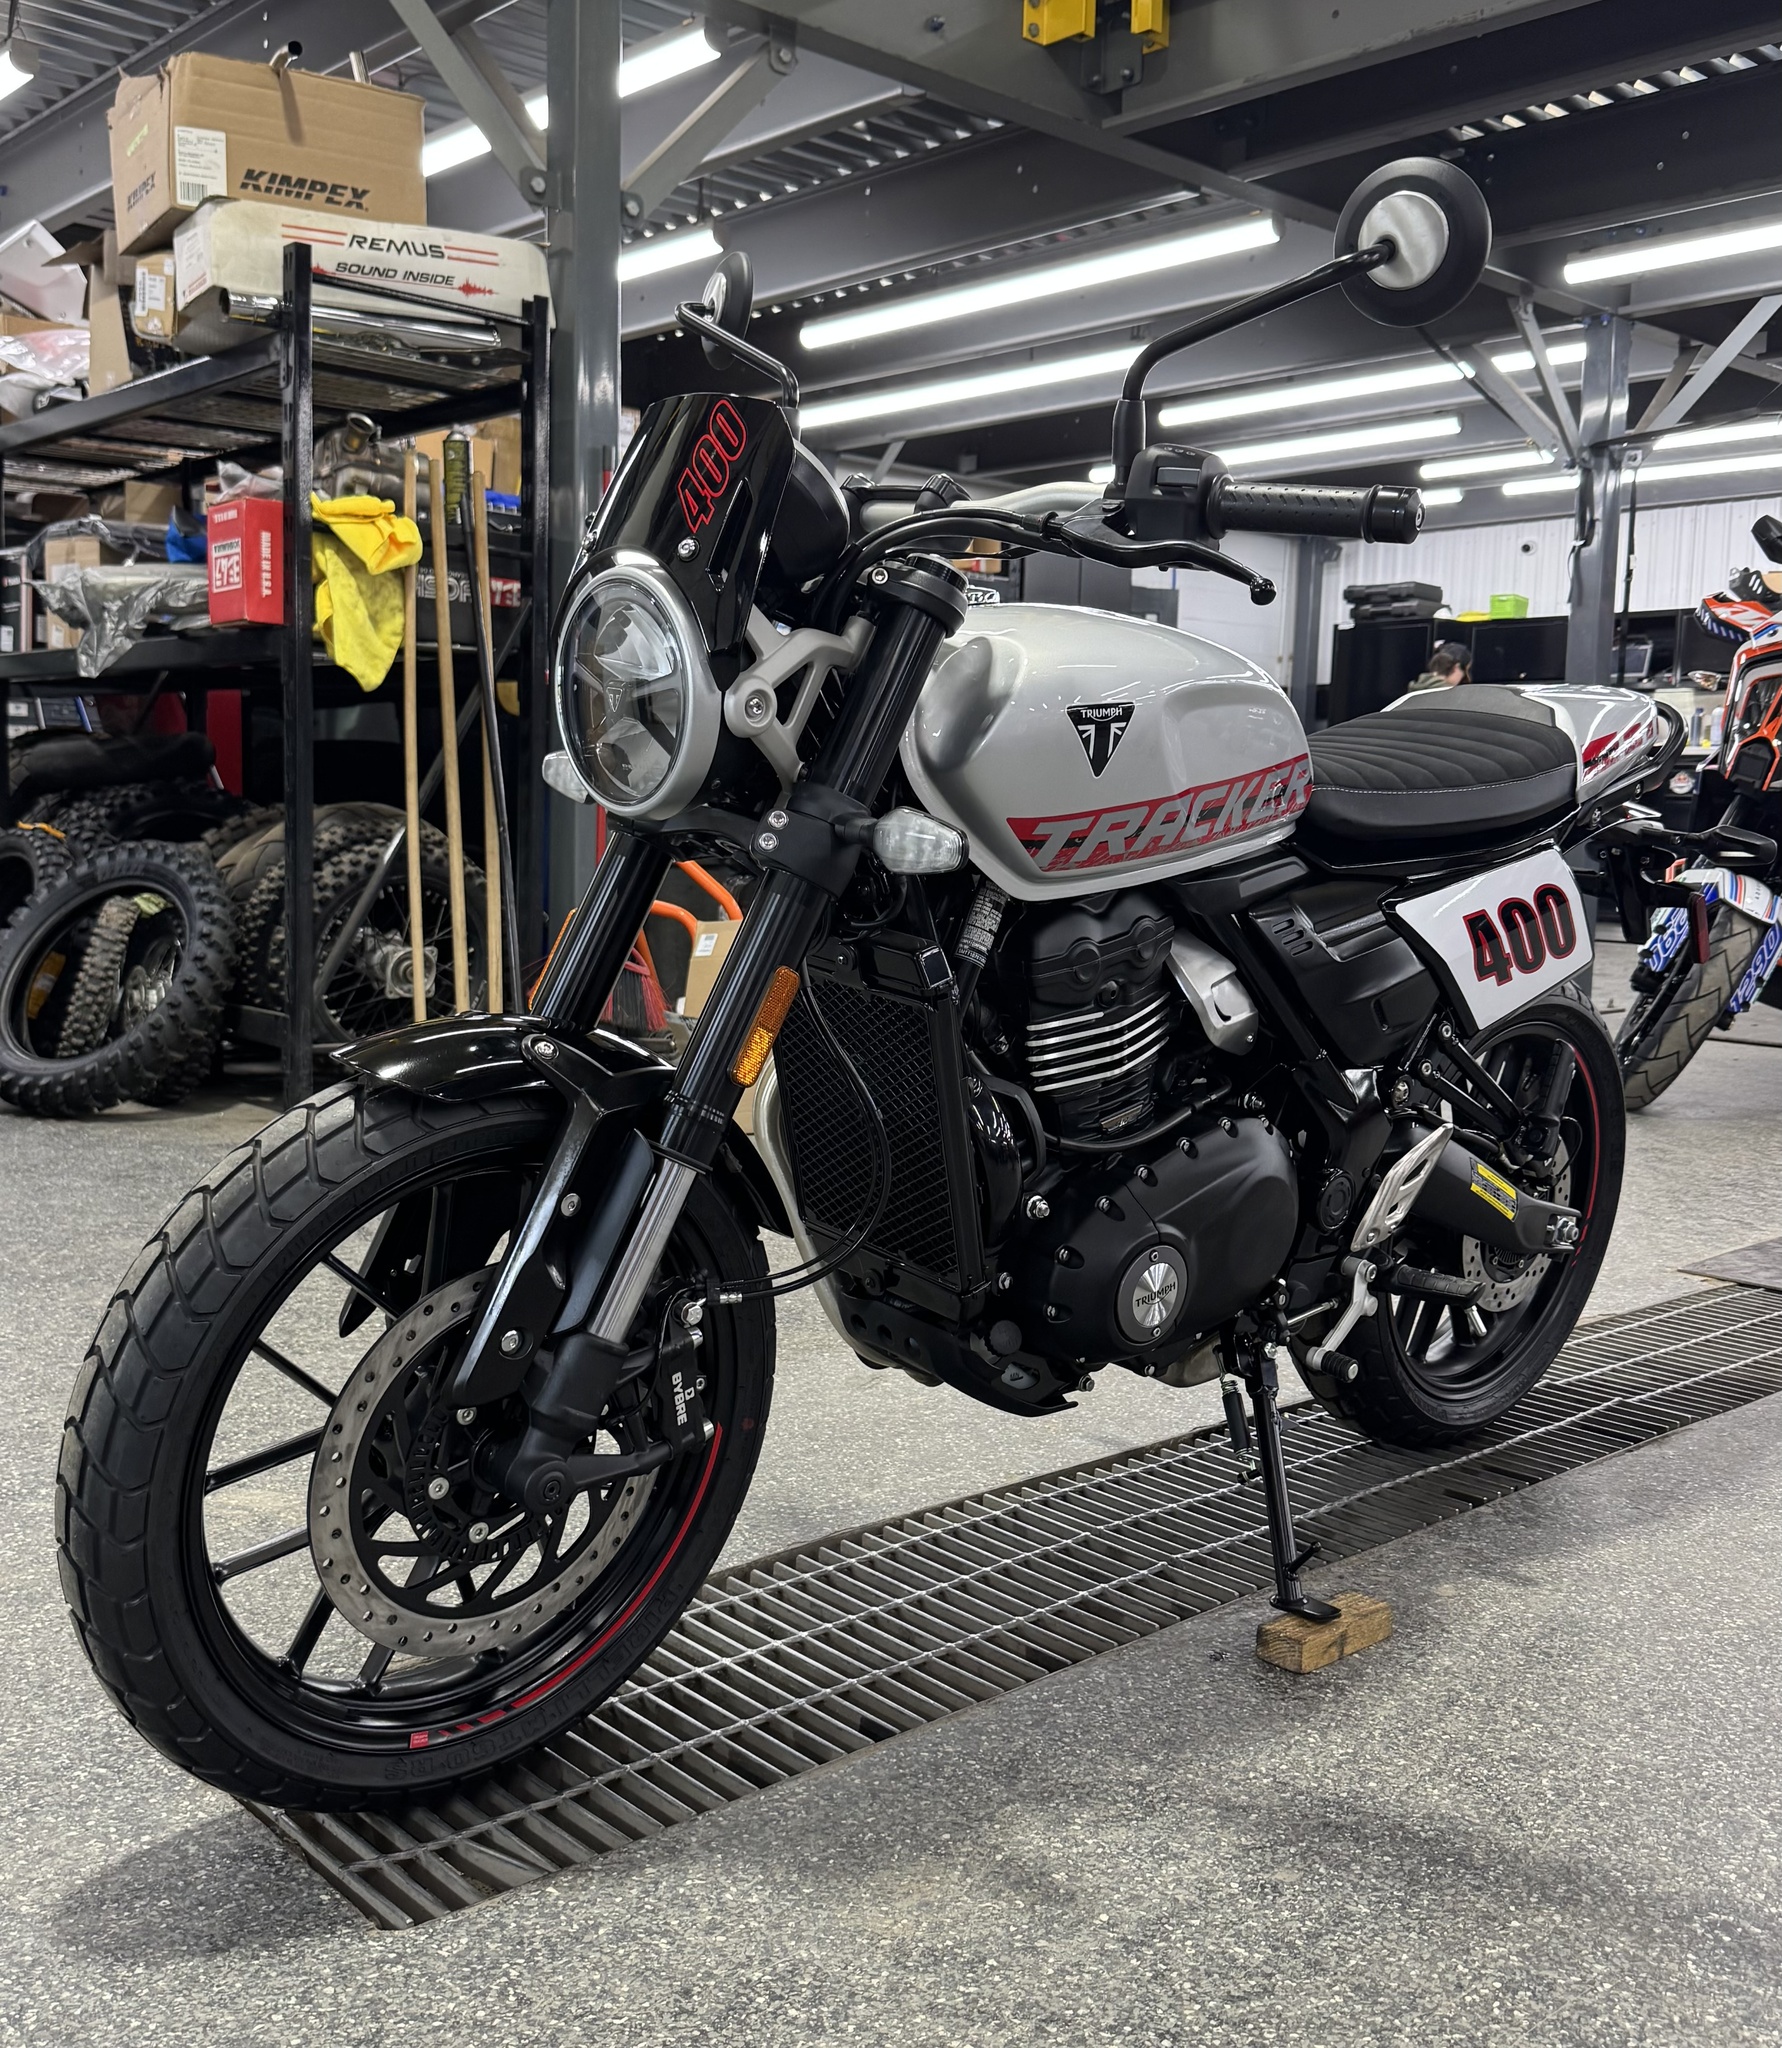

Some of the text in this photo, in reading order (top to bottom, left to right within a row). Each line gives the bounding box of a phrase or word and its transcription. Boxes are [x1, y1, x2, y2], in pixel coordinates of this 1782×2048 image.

[240, 168, 370, 210] KIMPEX
[349, 234, 445, 259] REMUS
[335, 262, 456, 286] SOUND INSIDE
[677, 399, 747, 533] 400
[1080, 707, 1123, 720] TRIUMPH
[1031, 759, 1310, 870] TRACKER
[1462, 883, 1577, 987] 400
[1135, 1281, 1177, 1307] TRIUMPH
[671, 1371, 688, 1426] BYBRE
